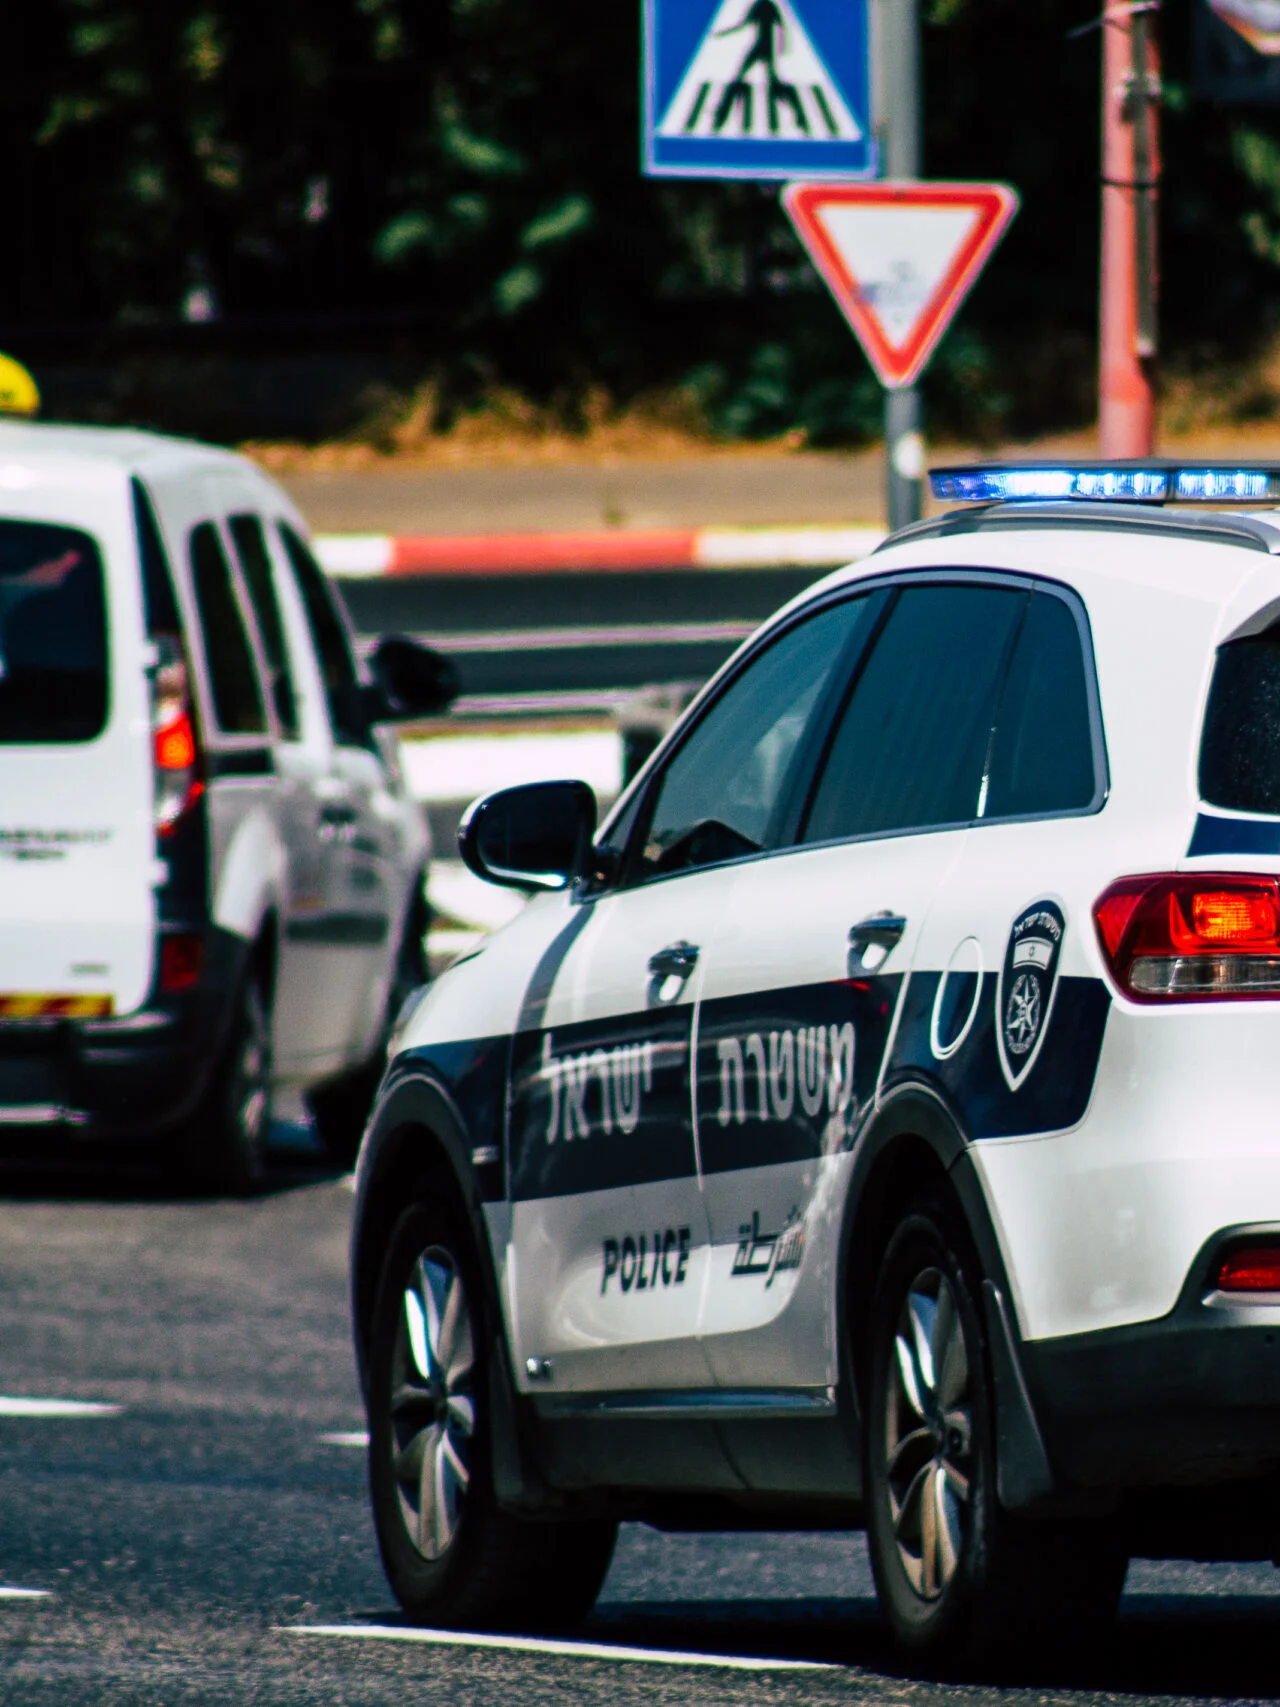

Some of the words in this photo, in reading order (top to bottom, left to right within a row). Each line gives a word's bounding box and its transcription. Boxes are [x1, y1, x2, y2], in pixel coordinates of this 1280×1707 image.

[541, 1031, 654, 1145] ישראל
[717, 1021, 855, 1128] משטרת
[600, 1227, 691, 1297] POLICE
